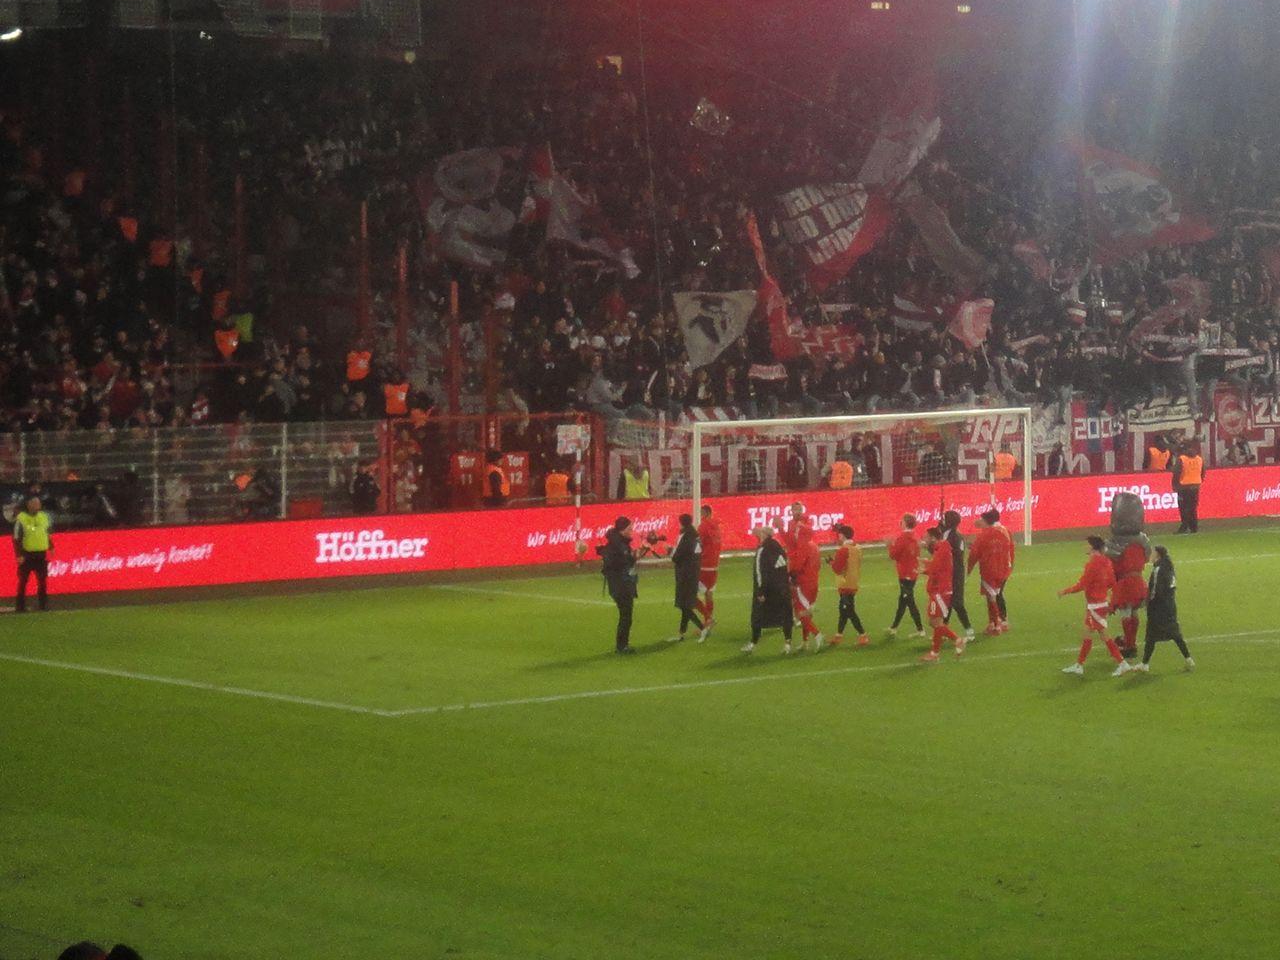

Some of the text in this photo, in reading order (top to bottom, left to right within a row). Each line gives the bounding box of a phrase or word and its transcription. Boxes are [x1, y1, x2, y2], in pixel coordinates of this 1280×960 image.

[1246, 489, 1261, 502] Wo
[549, 524, 593, 545] Wohen
[315, 529, 429, 563] Höffner
